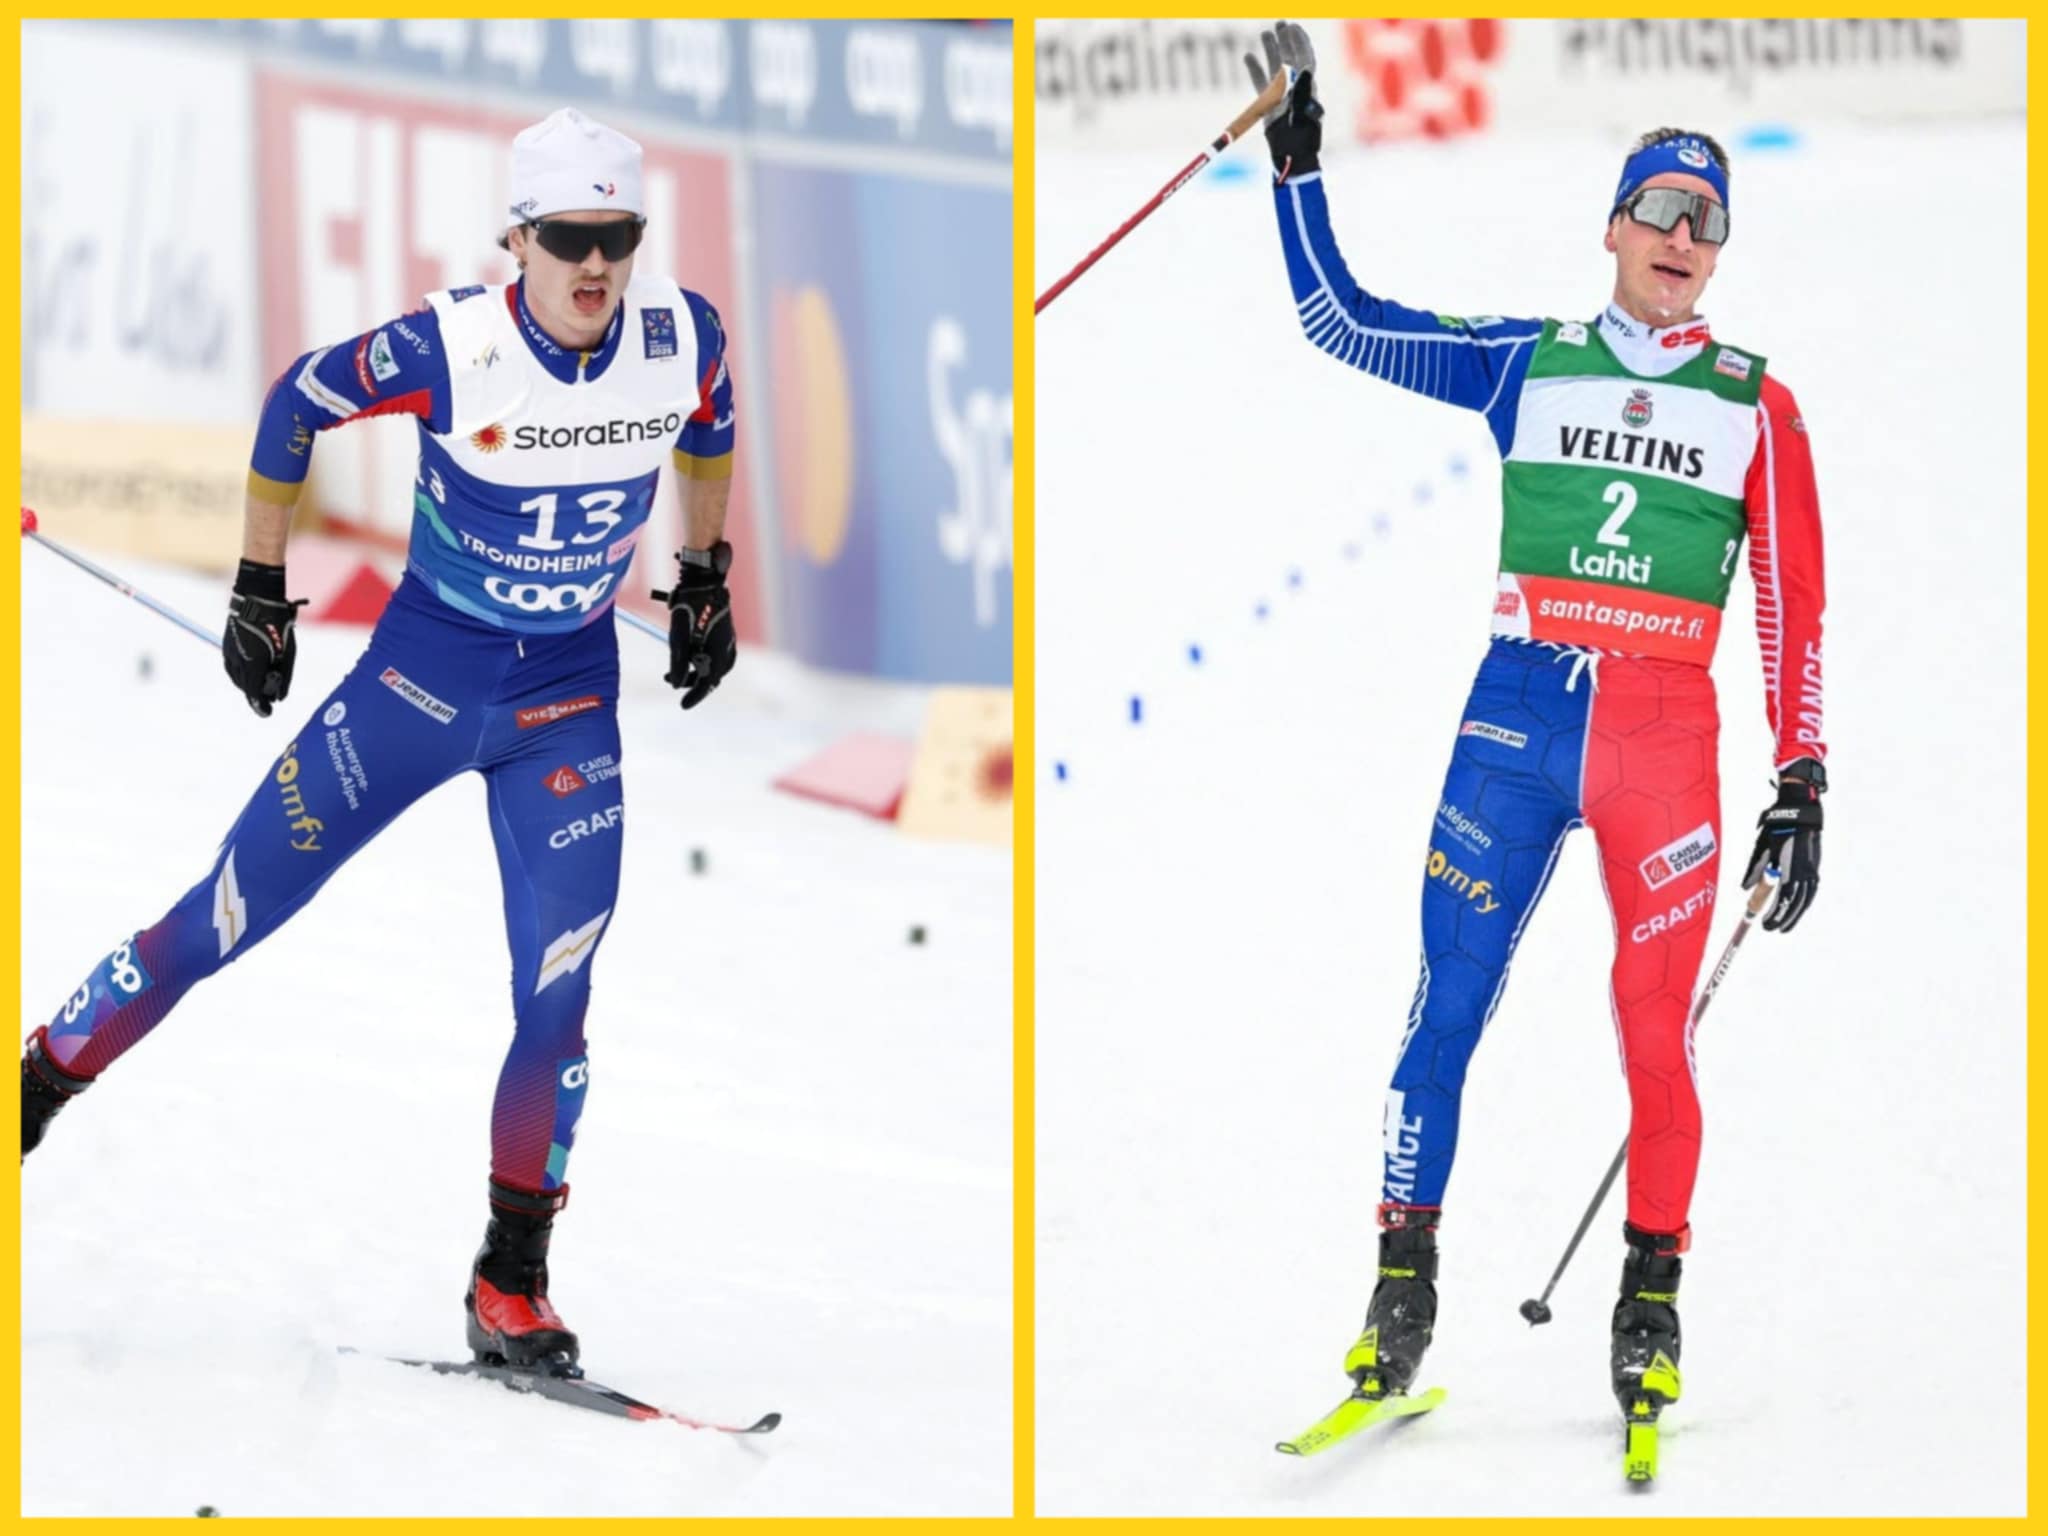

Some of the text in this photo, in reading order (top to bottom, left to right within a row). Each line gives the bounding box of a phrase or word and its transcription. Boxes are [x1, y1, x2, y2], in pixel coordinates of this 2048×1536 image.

[513, 413, 680, 450] StoraEnso
[1560, 425, 1704, 479] VELTINS
[517, 489, 627, 550] 13
[1595, 480, 1638, 547] 2
[459, 529, 604, 573] TRONDHEIM
[1569, 546, 1653, 584] Lahti
[1720, 538, 1737, 575] 2
[483, 572, 615, 613] coop
[1538, 597, 1705, 640] santasport.fi
[325, 730, 360, 811] Rhône-Alpes
[1631, 888, 1706, 943] CRAFT
